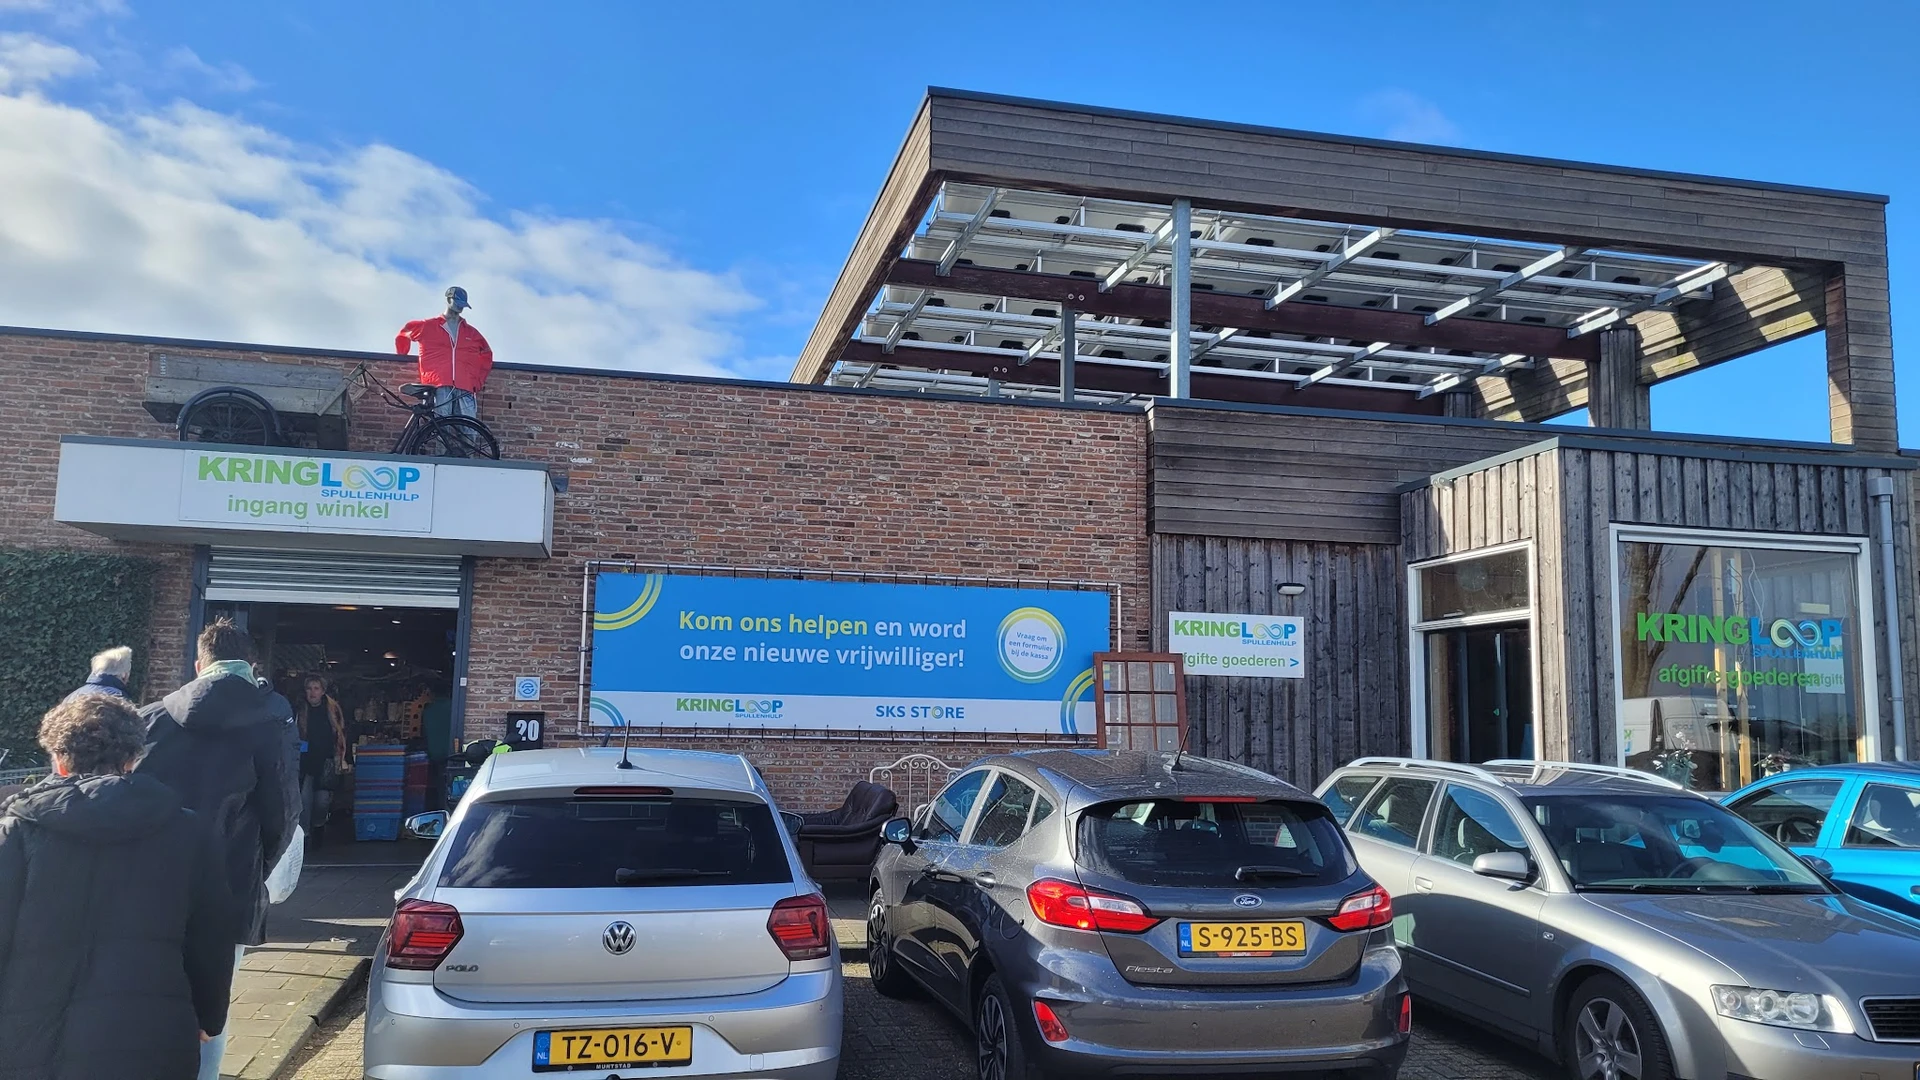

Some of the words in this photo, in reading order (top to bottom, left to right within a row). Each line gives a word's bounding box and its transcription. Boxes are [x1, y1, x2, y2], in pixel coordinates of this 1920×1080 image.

[198, 455, 420, 491] KRINGLOOP
[321, 489, 419, 501] SPULLENHULP
[227, 494, 308, 519] ingang
[316, 500, 389, 519] winkel
[679, 610, 733, 630] Kom
[740, 615, 782, 633] ons
[789, 614, 868, 639] helpen
[874, 619, 902, 636] en
[909, 619, 967, 638] word
[1174, 619, 1297, 640] KRINGLOOP
[1637, 612, 1842, 649] KRINGLOOP
[1016, 632, 1035, 641] Vraag
[1011, 648, 1020, 657] bij
[1030, 651, 1049, 659] kassa
[1022, 641, 1053, 651] formulier
[679, 643, 737, 661] onze
[743, 642, 830, 664] nieuwe
[836, 645, 965, 672] vrijwilliger!
[1182, 652, 1218, 667] fgifte
[1222, 654, 1286, 668] goederen
[1658, 663, 1722, 687] afgifte
[1726, 666, 1820, 688] goederen
[676, 698, 783, 713] KRINGLOOP
[875, 705, 906, 718] SKS
[910, 706, 965, 719] STORE
[515, 719, 540, 741] 20
[1238, 897, 1257, 906] Ford
[1199, 926, 1298, 947] S-925-BS
[445, 964, 479, 973] POLO
[1125, 965, 1174, 974] Fiesta
[536, 1052, 548, 1060] NL
[562, 1032, 675, 1060] TZ-016-V
